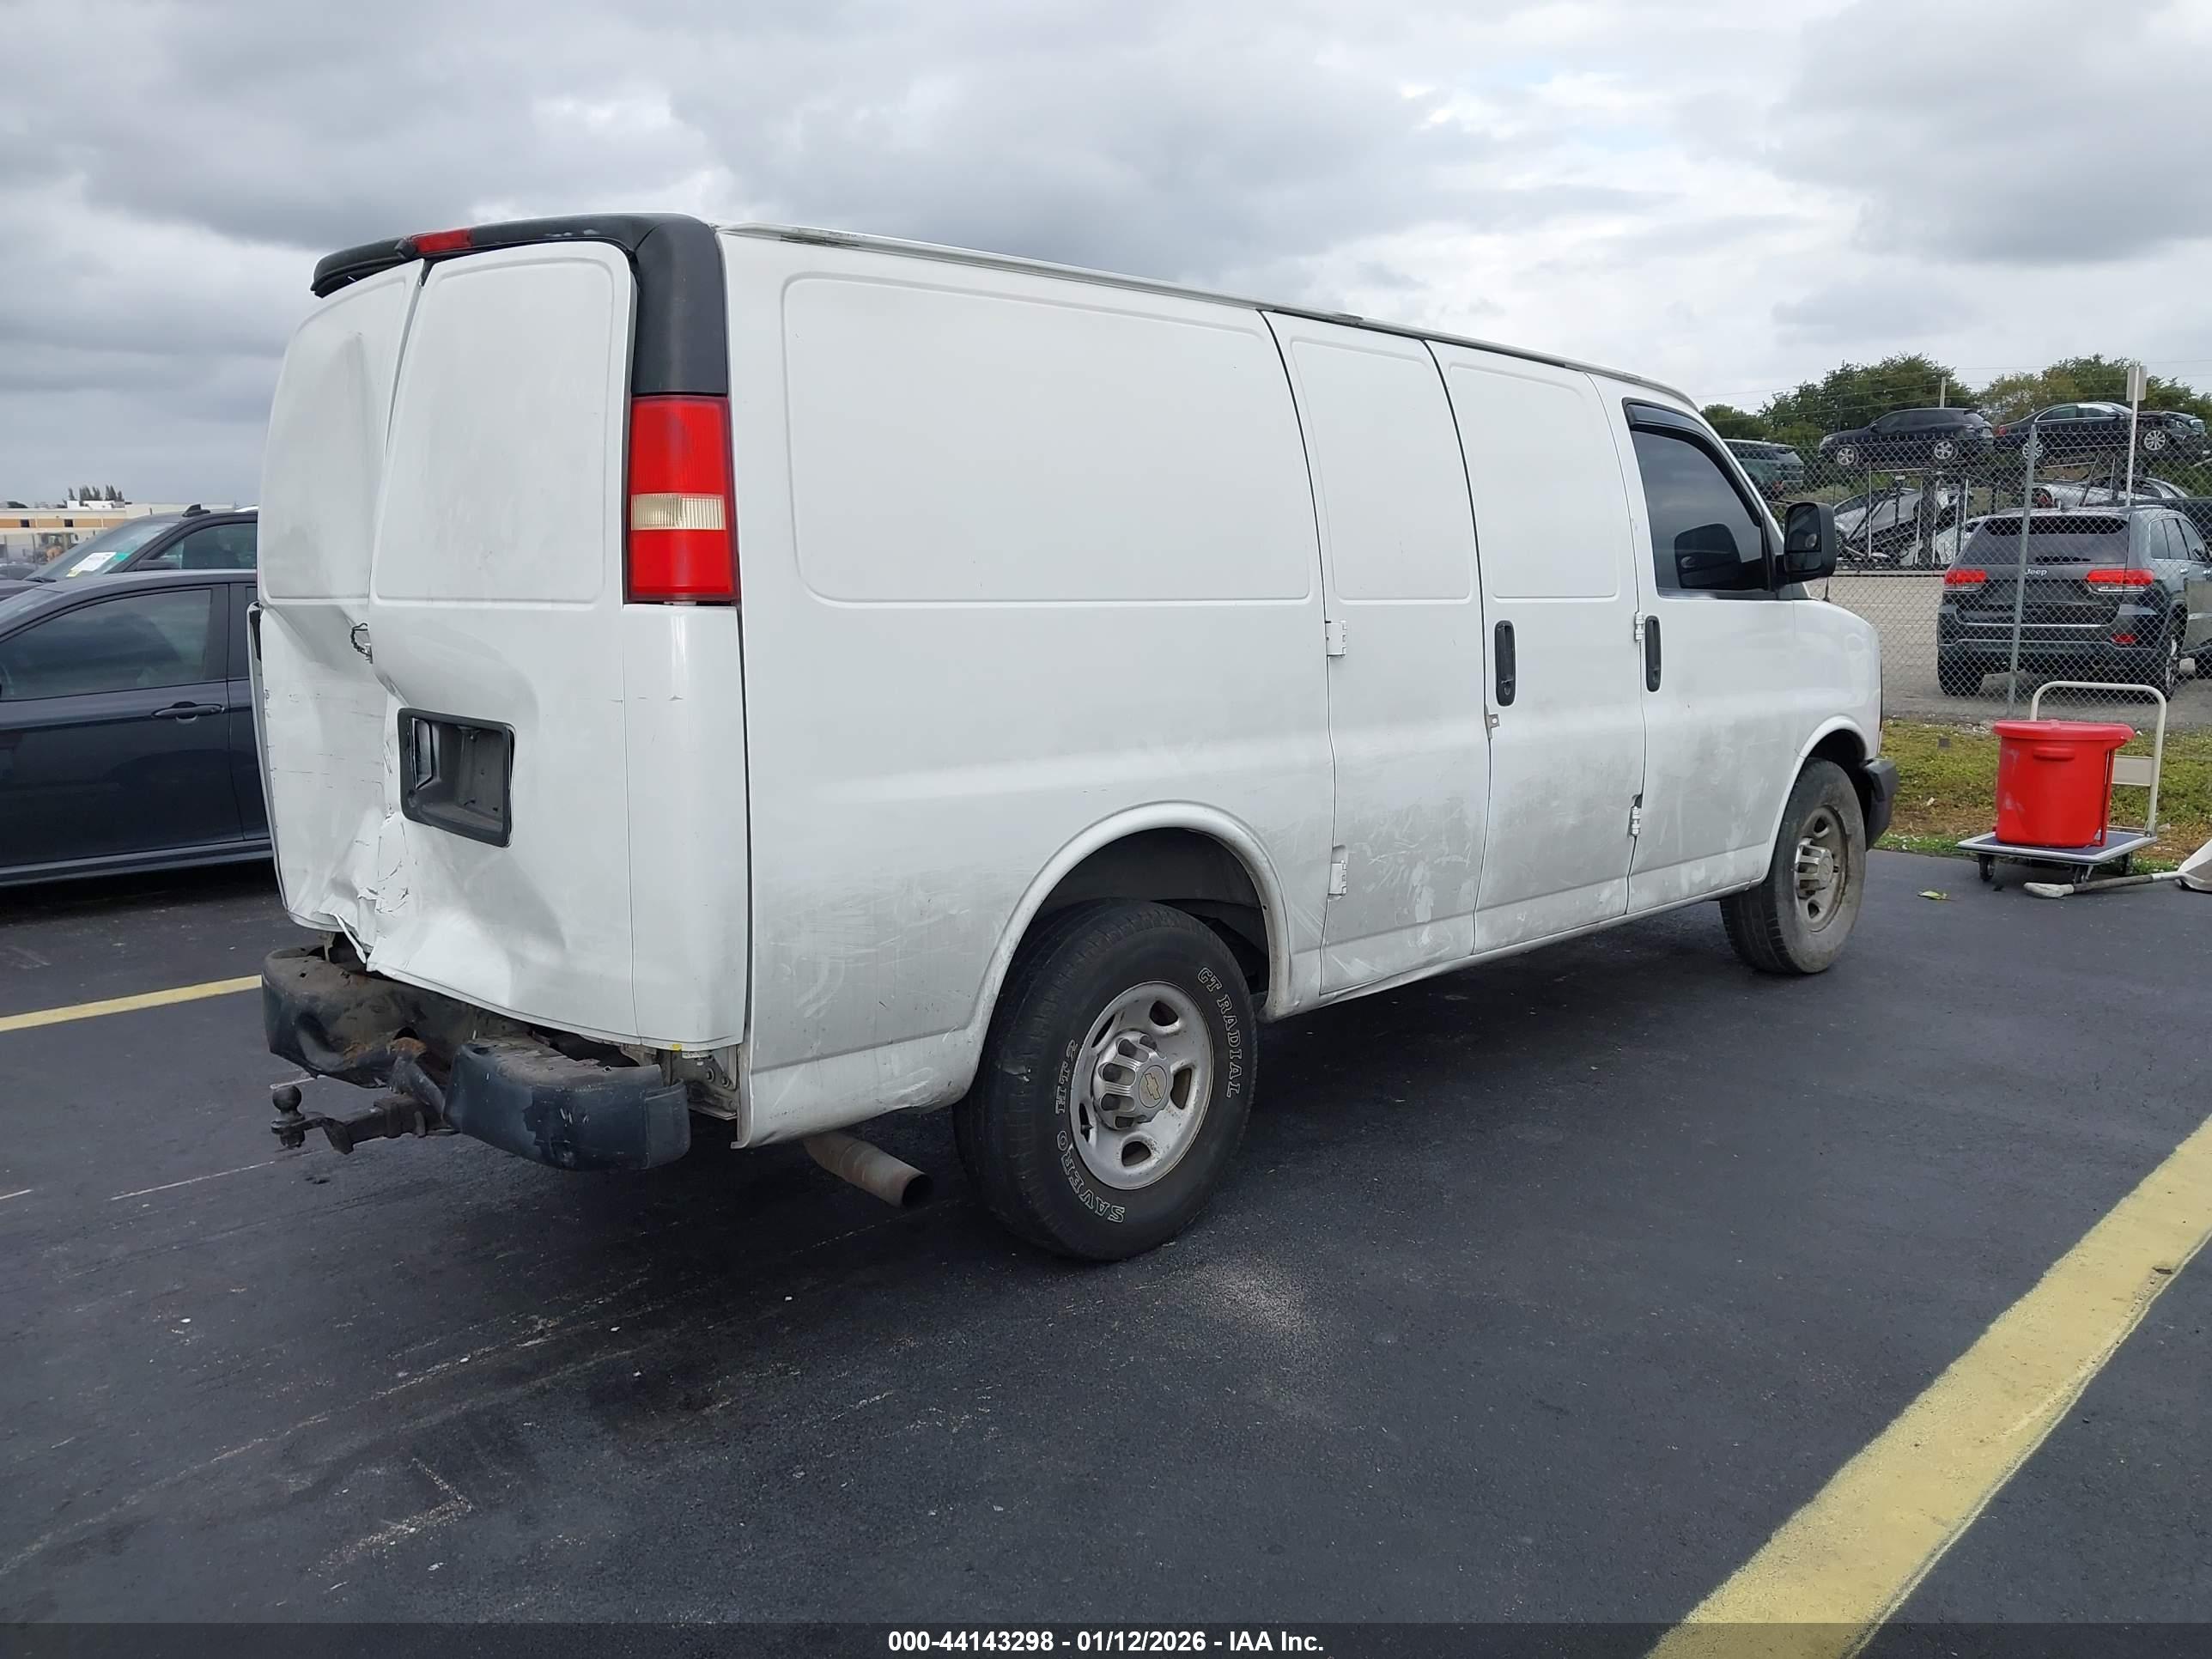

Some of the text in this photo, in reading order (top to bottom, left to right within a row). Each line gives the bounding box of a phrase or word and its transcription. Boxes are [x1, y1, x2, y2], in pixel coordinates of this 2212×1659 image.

[2025, 568, 2048, 577] Jeep
[1198, 967, 1243, 1099] GT RADIAL
[1056, 1130, 1126, 1224] SAVERO
